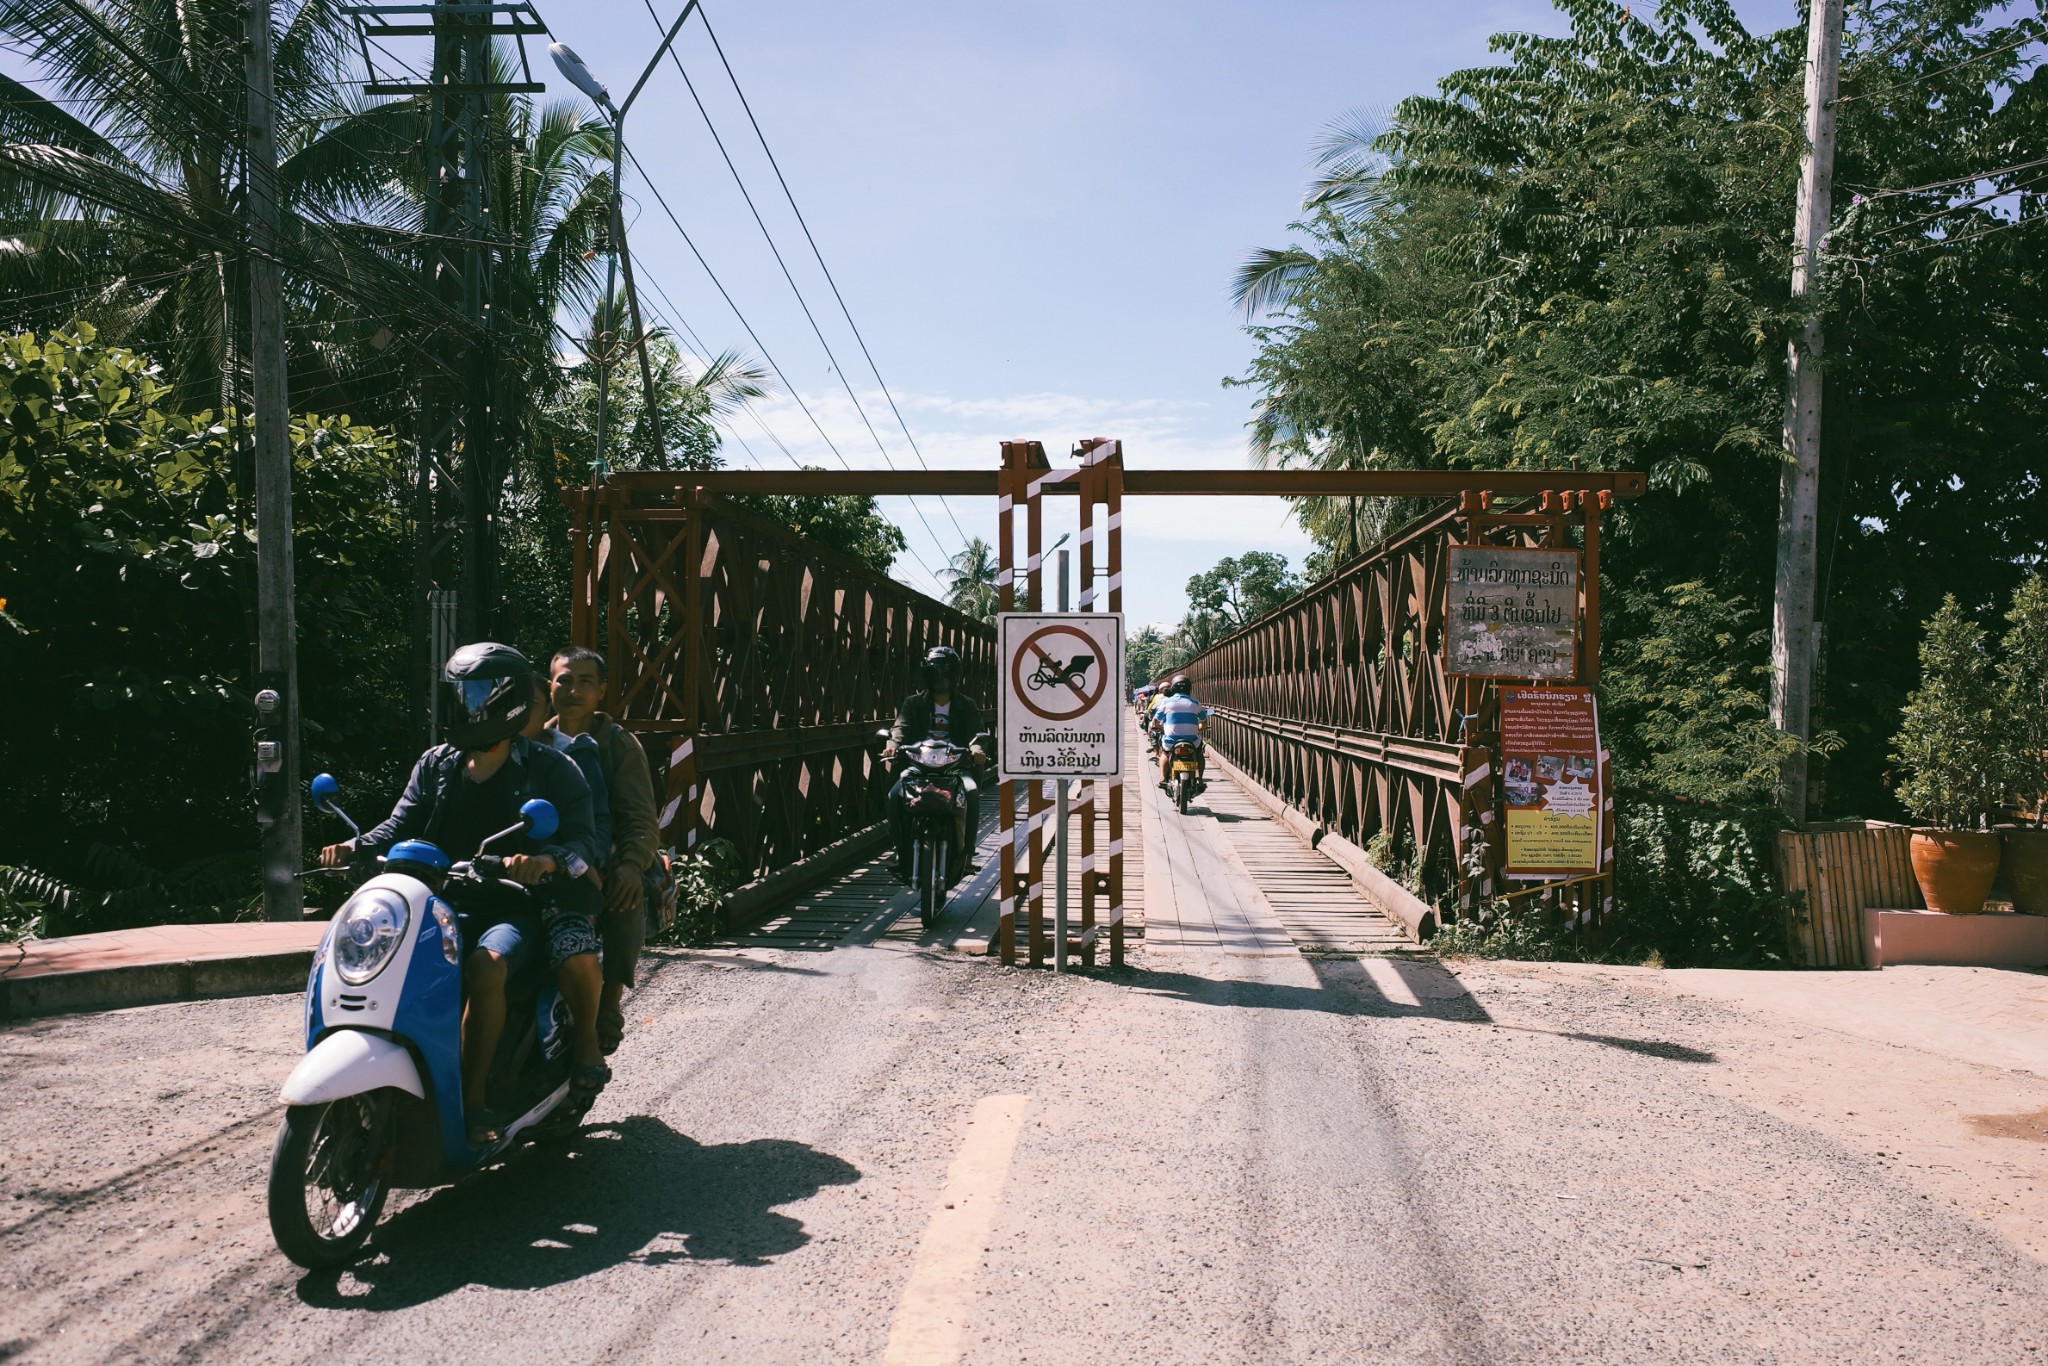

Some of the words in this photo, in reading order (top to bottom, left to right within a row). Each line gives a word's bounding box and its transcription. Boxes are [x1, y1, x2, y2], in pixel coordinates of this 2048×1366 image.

[1019, 725, 1106, 748] ຫ້າມລົດບັນທຸກ
